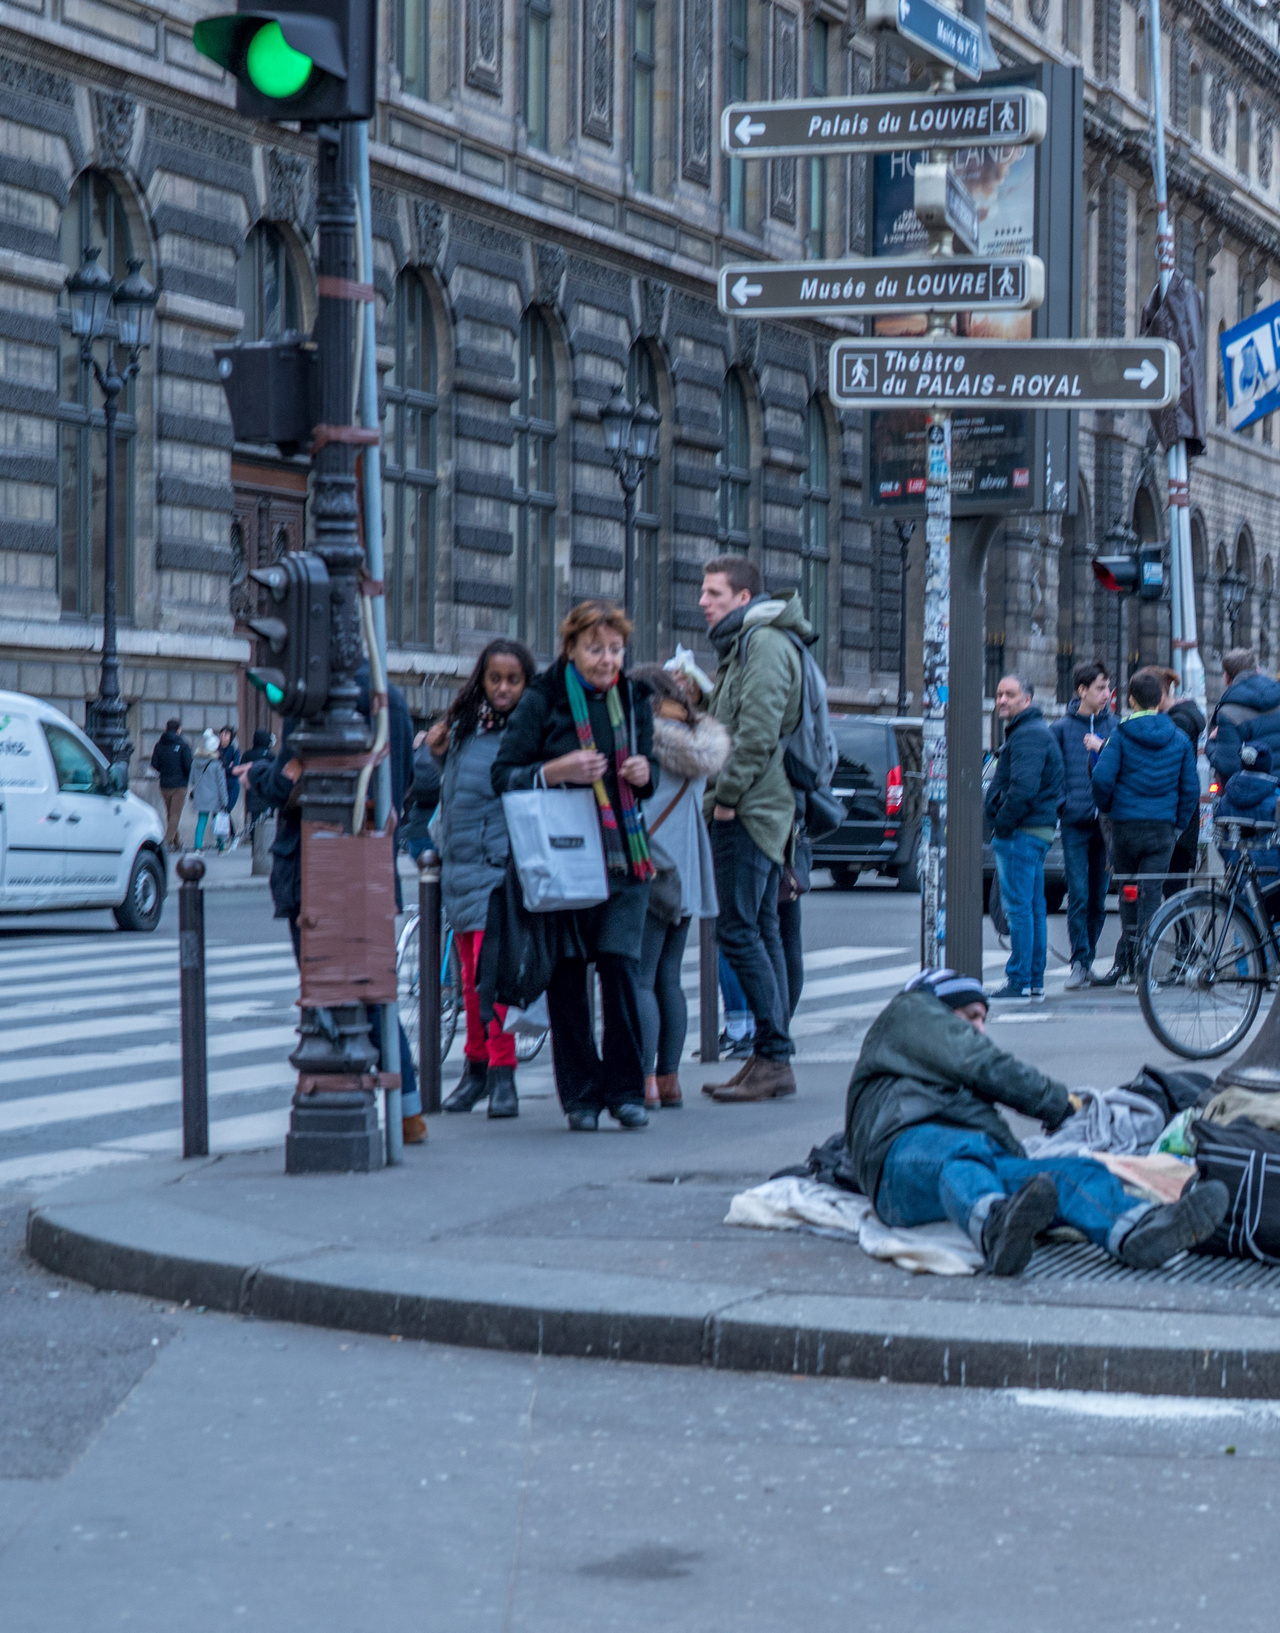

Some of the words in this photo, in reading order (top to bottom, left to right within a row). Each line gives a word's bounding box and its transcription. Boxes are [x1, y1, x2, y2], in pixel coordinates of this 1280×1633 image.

[808, 113, 869, 138] Palais
[878, 111, 901, 134] du
[908, 105, 990, 132] LOUVRE
[800, 277, 866, 301] Musée
[875, 276, 898, 298] du
[906, 272, 988, 297] LOUVRE
[884, 350, 966, 373] Théâtre
[882, 375, 907, 395] du
[915, 373, 1082, 397] PALAIS-ROYAL
